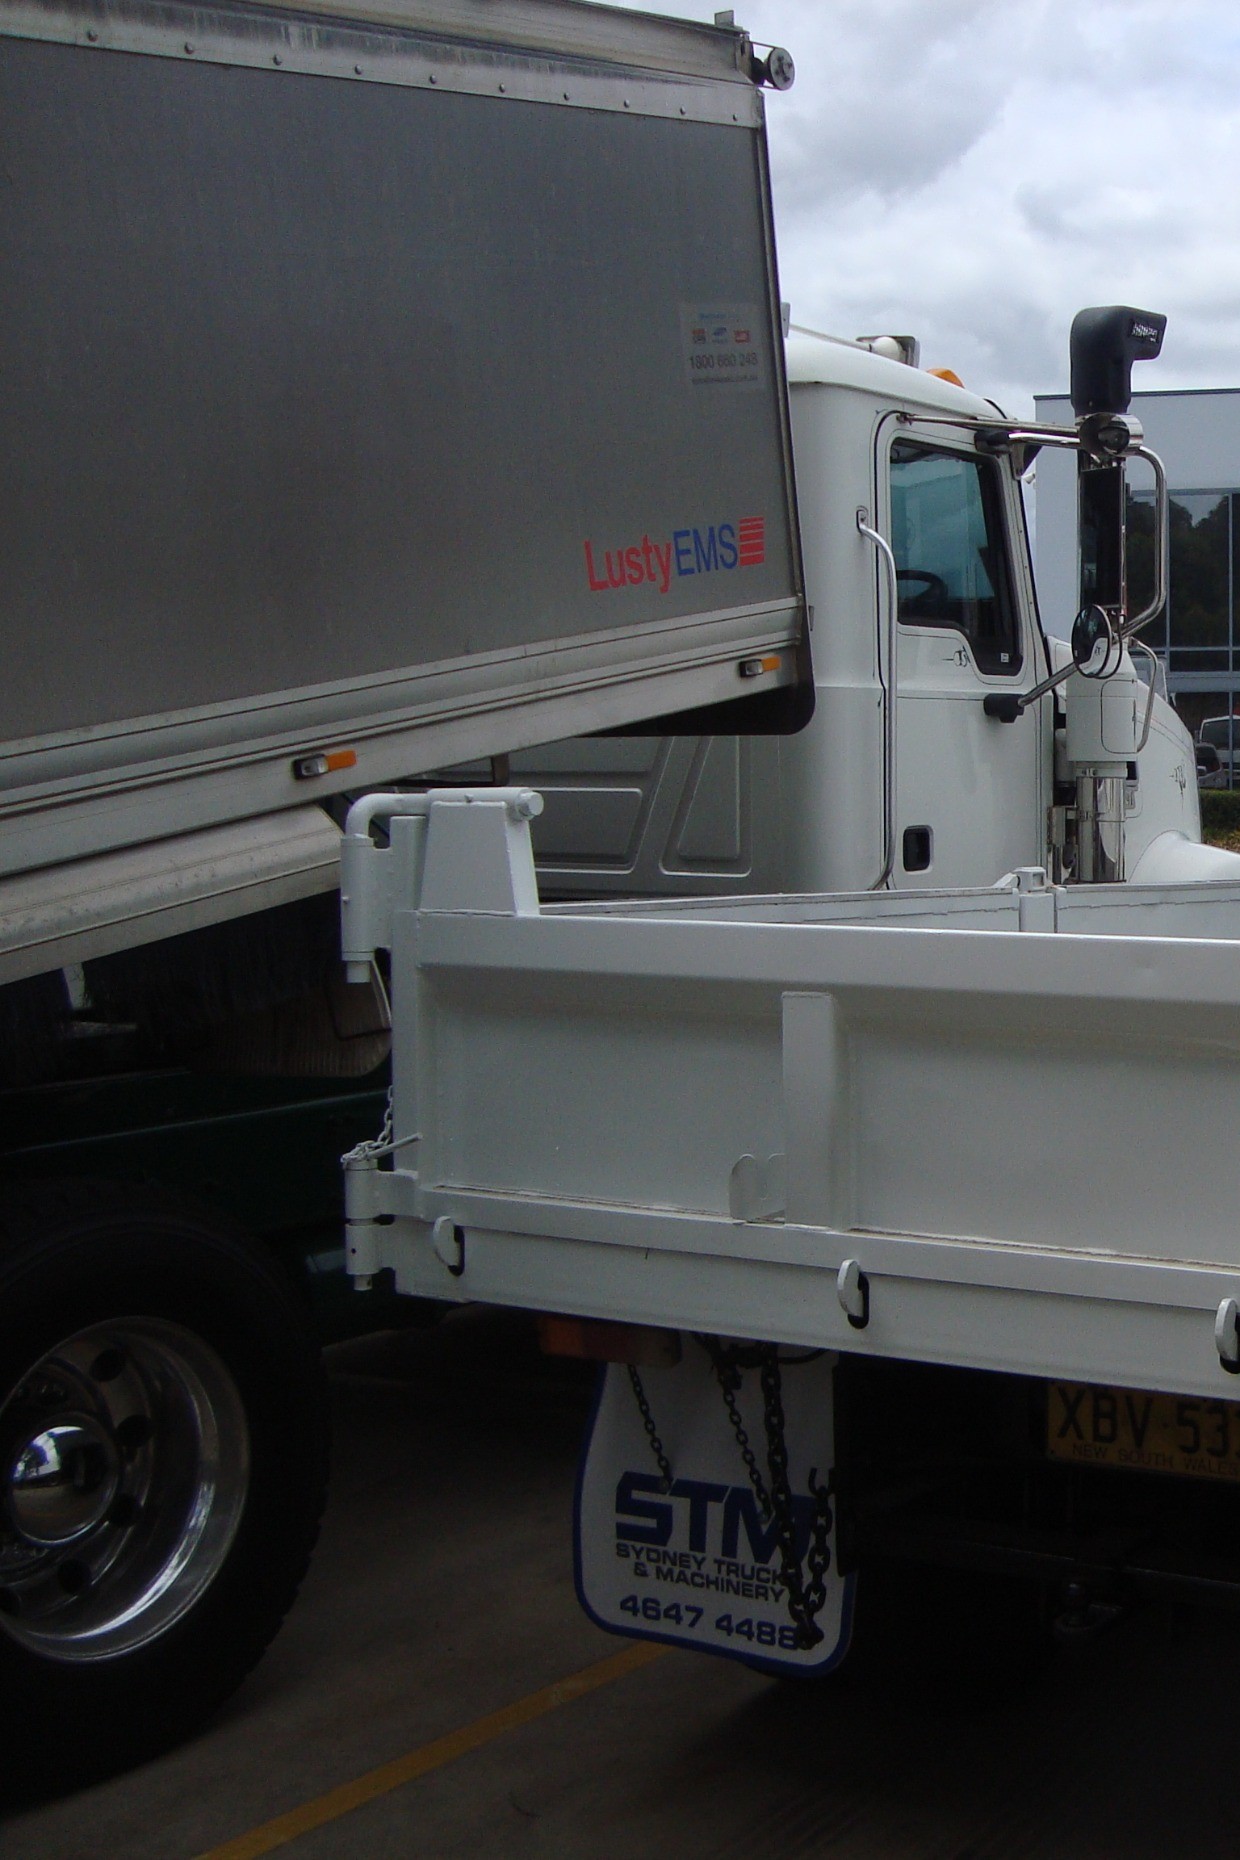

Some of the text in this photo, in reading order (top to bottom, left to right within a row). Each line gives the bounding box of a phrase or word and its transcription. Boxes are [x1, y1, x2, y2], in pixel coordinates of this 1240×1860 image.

[583, 523, 739, 594] LustyEMS
[1056, 1386, 1153, 1449] XBV
[1072, 1443, 1109, 1460] NEW
[1118, 1448, 1174, 1469] SOUTH
[615, 1471, 816, 1565] STM
[615, 1541, 801, 1588] SYDNEY TRUCK
[633, 1561, 786, 1603] & MACHINERY
[619, 1594, 799, 1651] 4647 4488
